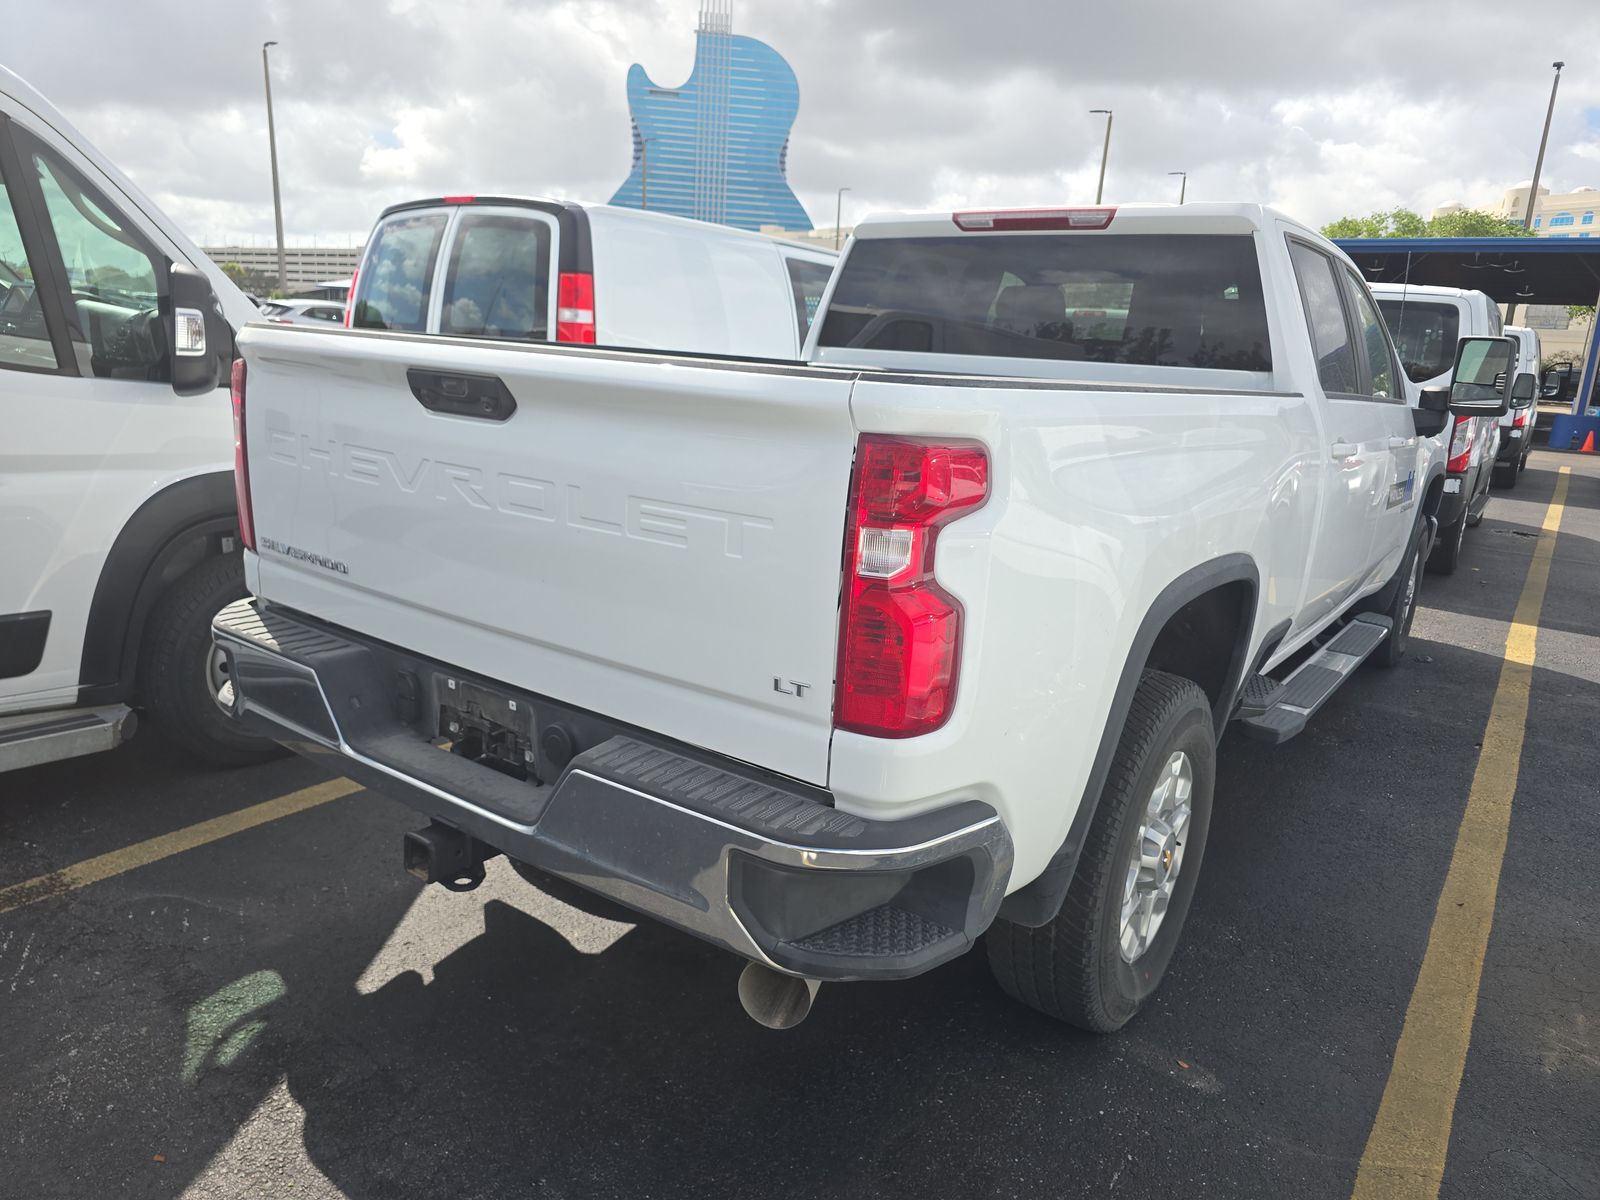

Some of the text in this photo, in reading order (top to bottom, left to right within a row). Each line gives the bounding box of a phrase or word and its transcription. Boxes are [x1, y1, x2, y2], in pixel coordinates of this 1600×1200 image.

[266, 428, 774, 559] CHEVROLET
[260, 536, 349, 574] SILVERADO
[773, 676, 811, 698] LT
